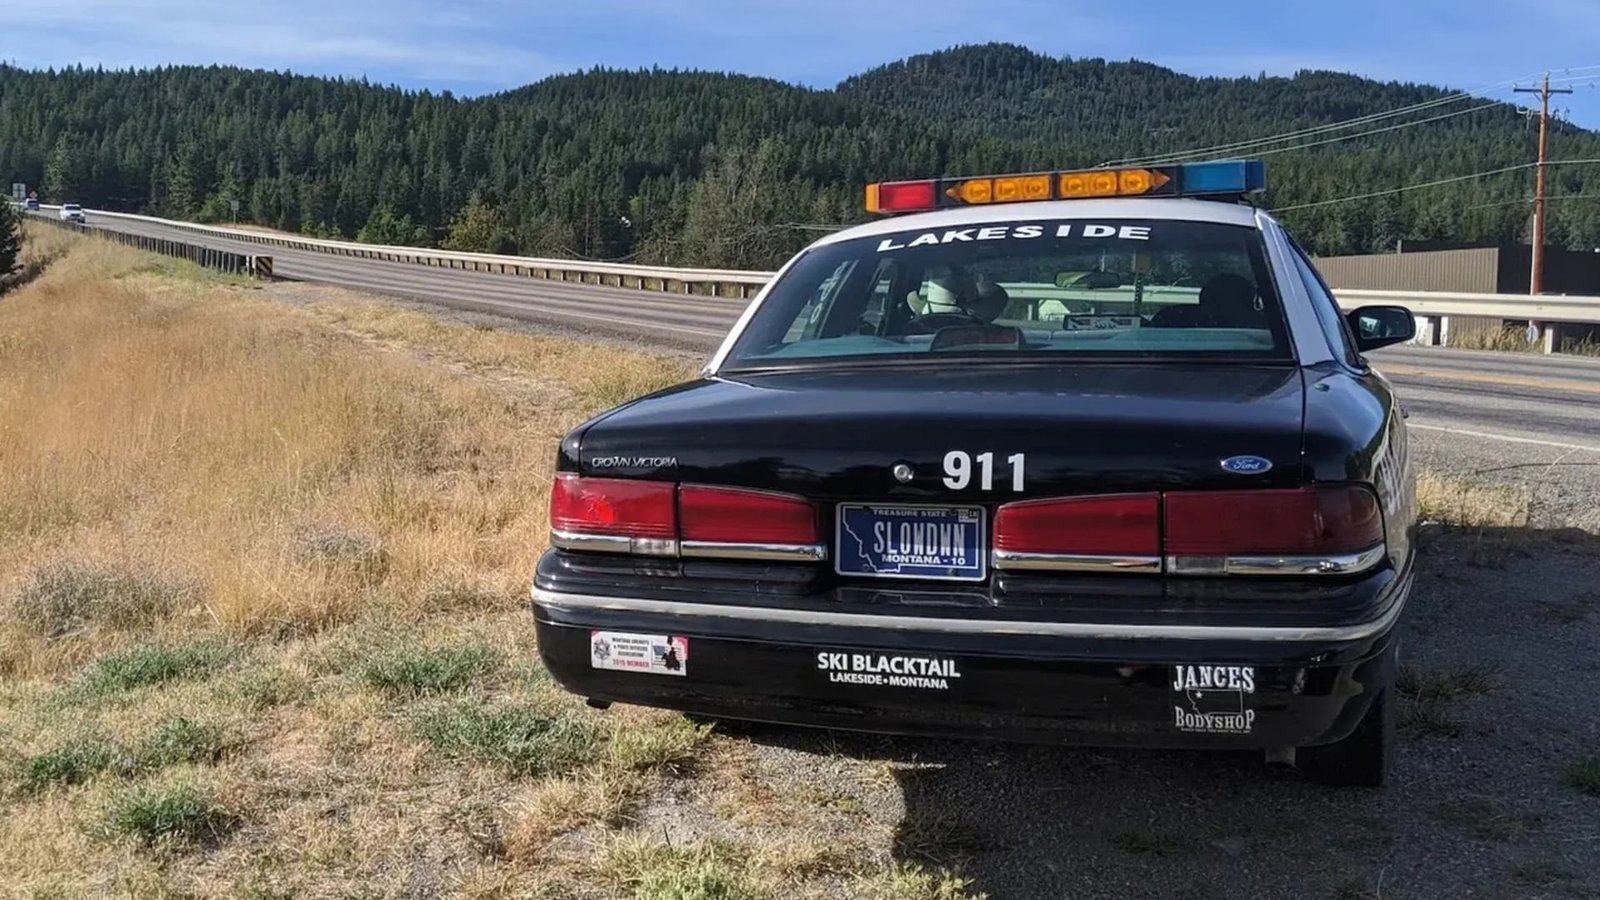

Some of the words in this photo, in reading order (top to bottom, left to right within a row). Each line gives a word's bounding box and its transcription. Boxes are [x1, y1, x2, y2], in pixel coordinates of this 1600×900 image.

[876, 224, 1151, 252] LAKESIDE
[591, 456, 631, 468] CROWN
[632, 457, 679, 469] VICTORIA
[943, 450, 1025, 492] 911
[873, 509, 918, 518] TREASURE
[921, 510, 947, 518] STATE
[873, 521, 966, 557] SLOWDWN
[881, 554, 941, 565] MONTANA
[952, 557, 966, 566] 10
[817, 652, 848, 670] SKI
[852, 654, 961, 678] BLACKTAIL
[1173, 665, 1255, 694] JANCES
[1174, 705, 1255, 730] BODYSHOP
